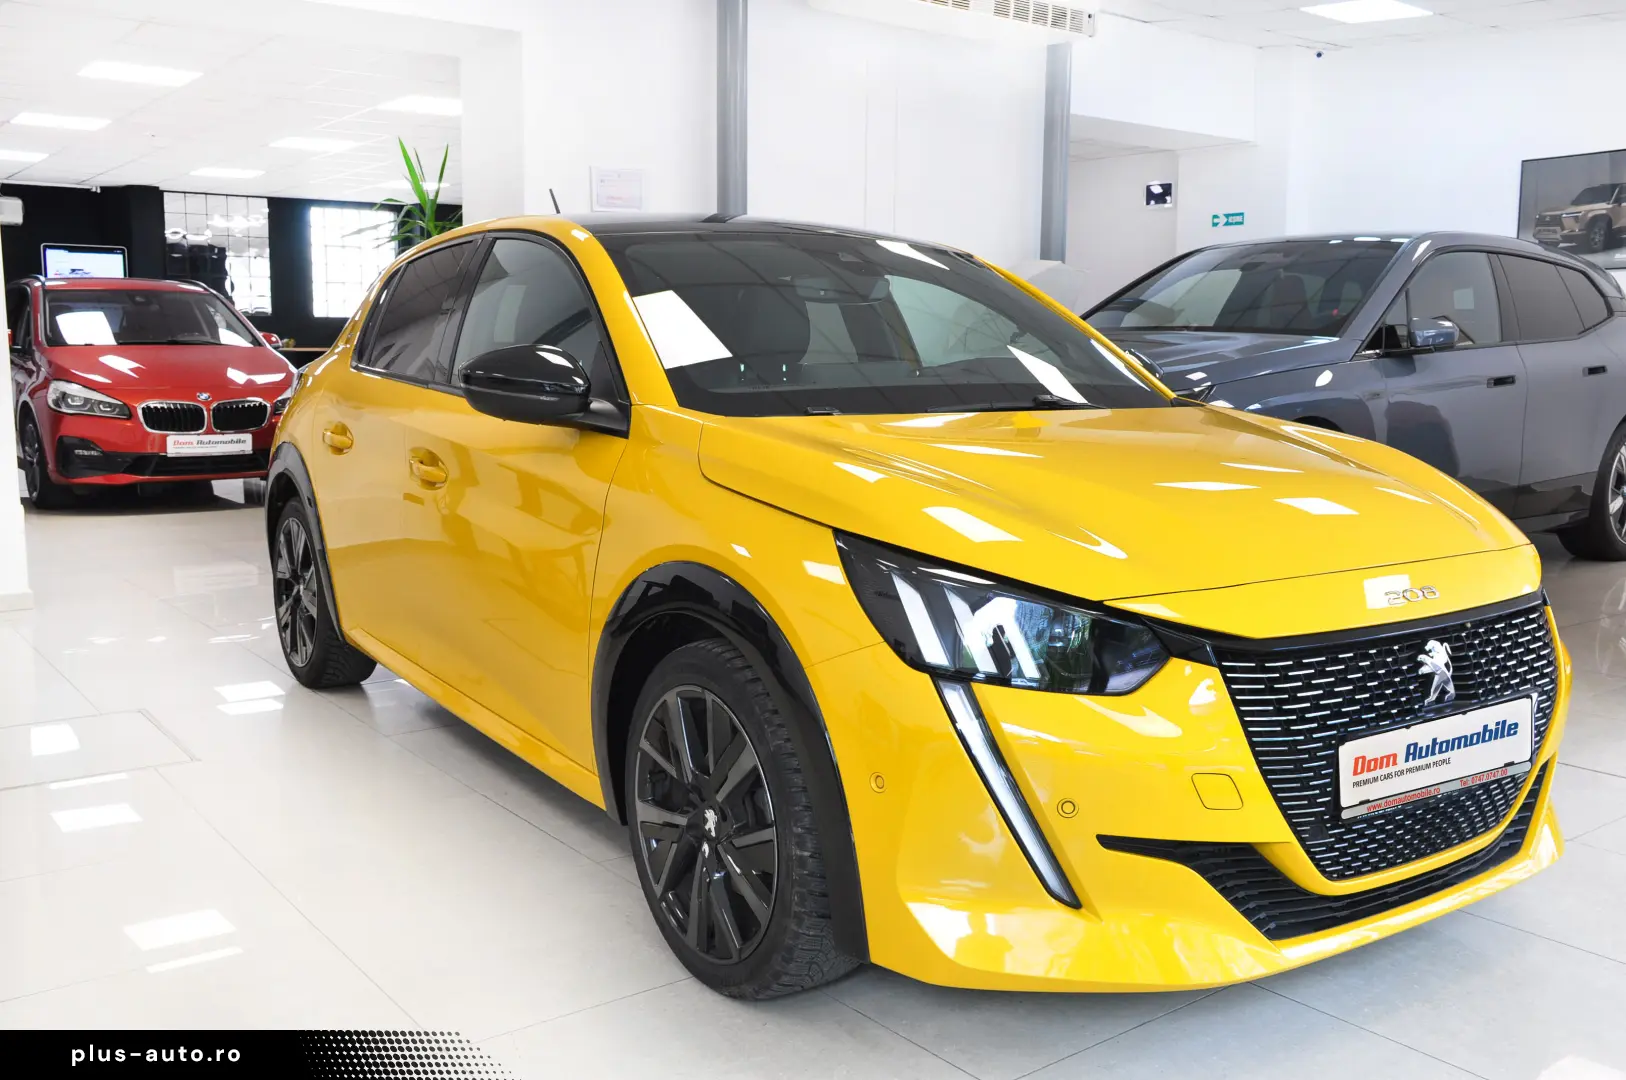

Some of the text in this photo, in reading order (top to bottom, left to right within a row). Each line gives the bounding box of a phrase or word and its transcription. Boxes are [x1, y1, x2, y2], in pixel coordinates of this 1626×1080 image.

[196, 438, 247, 446] Automobile
[1384, 585, 1440, 606] 208
[1352, 719, 1519, 777] Dom Automobile
[1352, 757, 1452, 789] PREMIUM CARS FOR PREMIUM PEOPLE
[1366, 768, 1508, 813] www.domautomobile.ro Tel: 0747.0747.00
